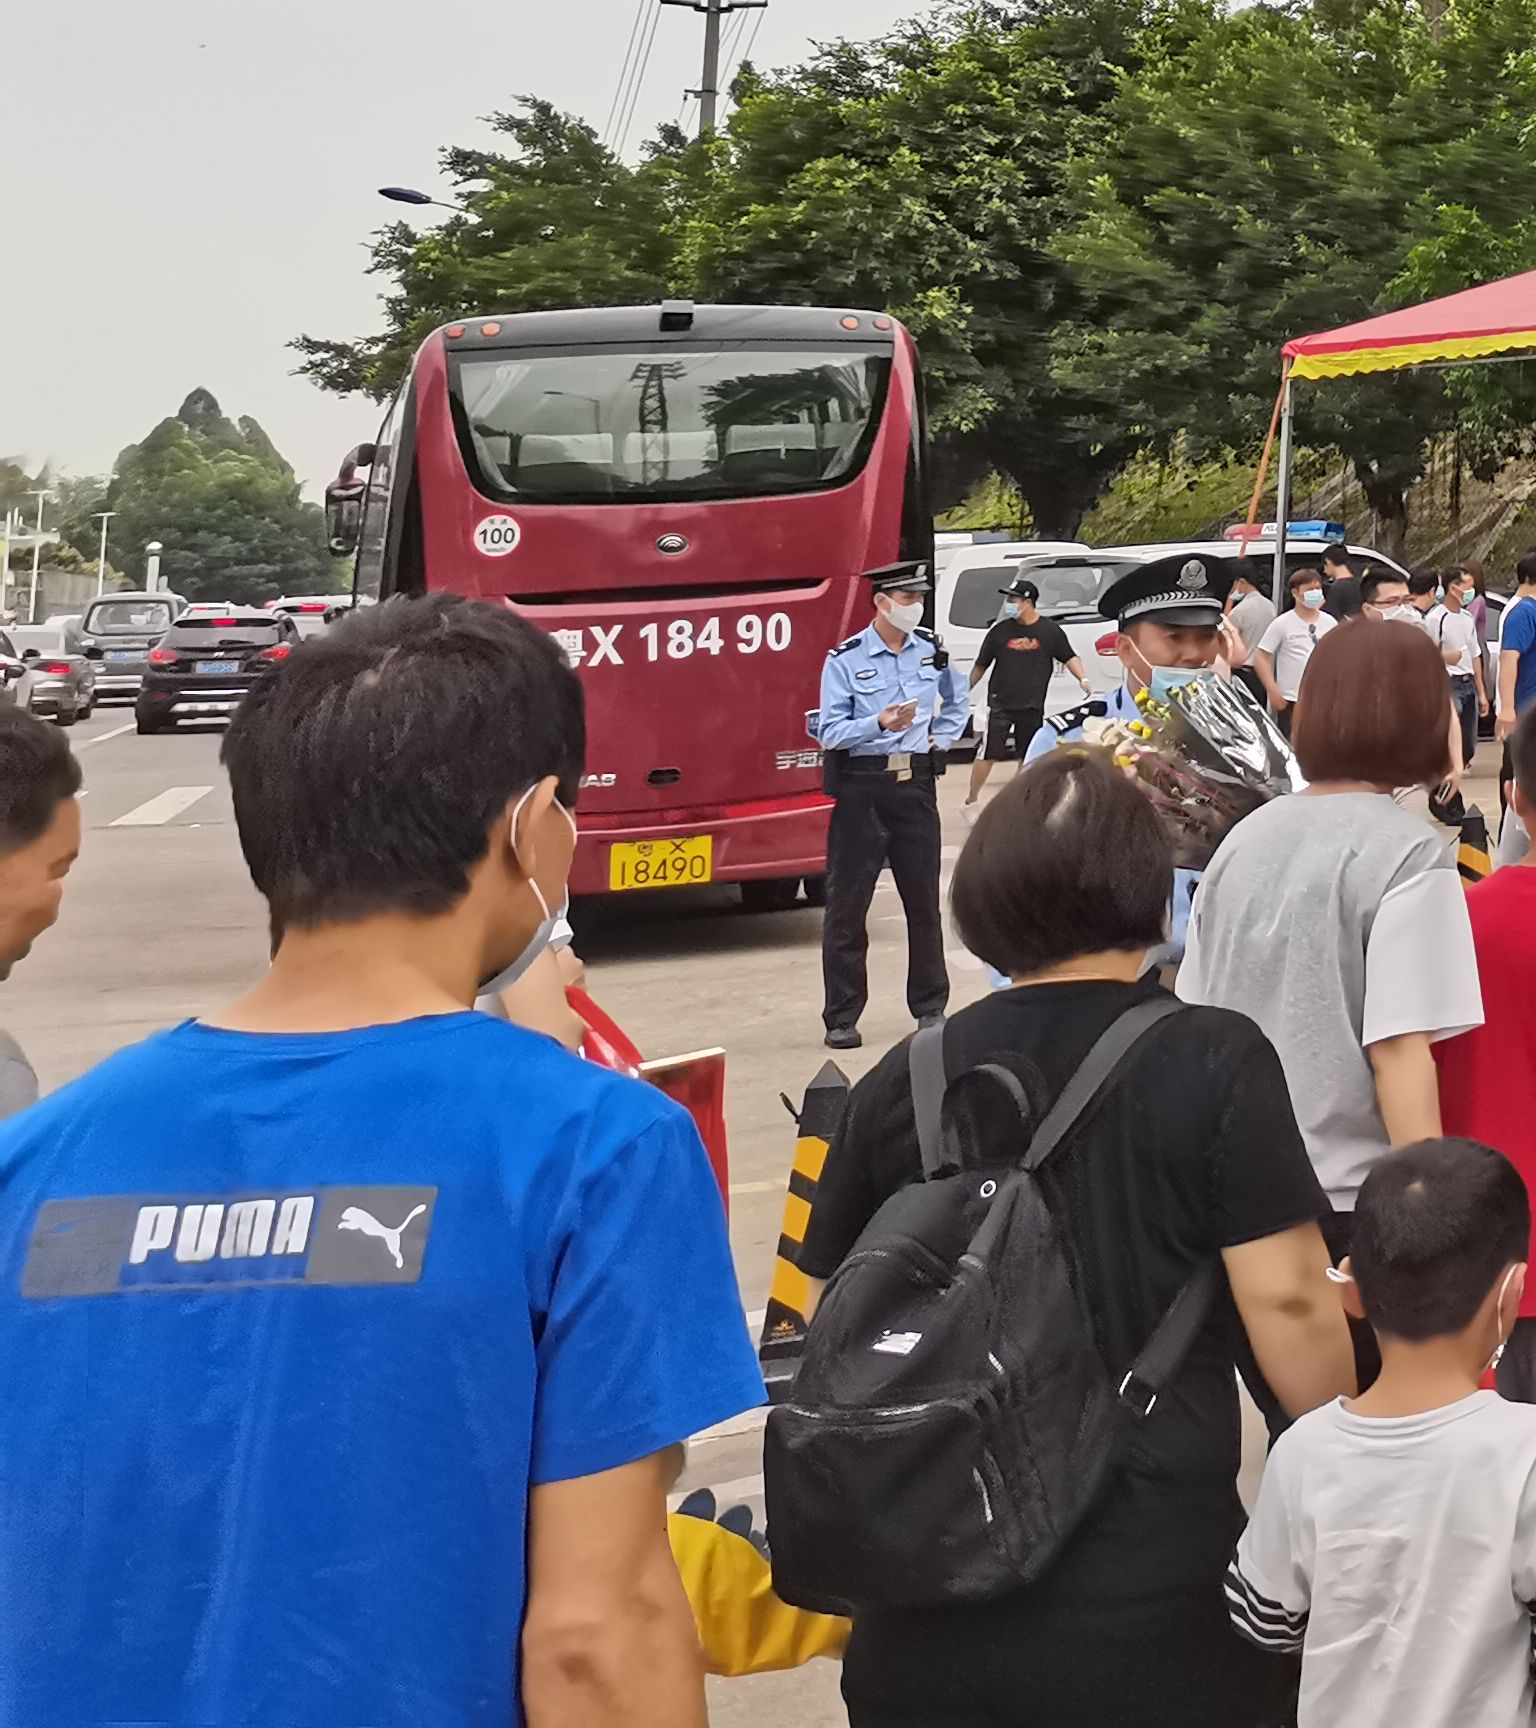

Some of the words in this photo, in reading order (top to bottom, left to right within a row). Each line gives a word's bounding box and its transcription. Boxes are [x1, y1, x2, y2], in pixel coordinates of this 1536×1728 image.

[479, 527, 515, 544] 100
[621, 855, 706, 885] 18490
[129, 1196, 314, 1264] PUMA
